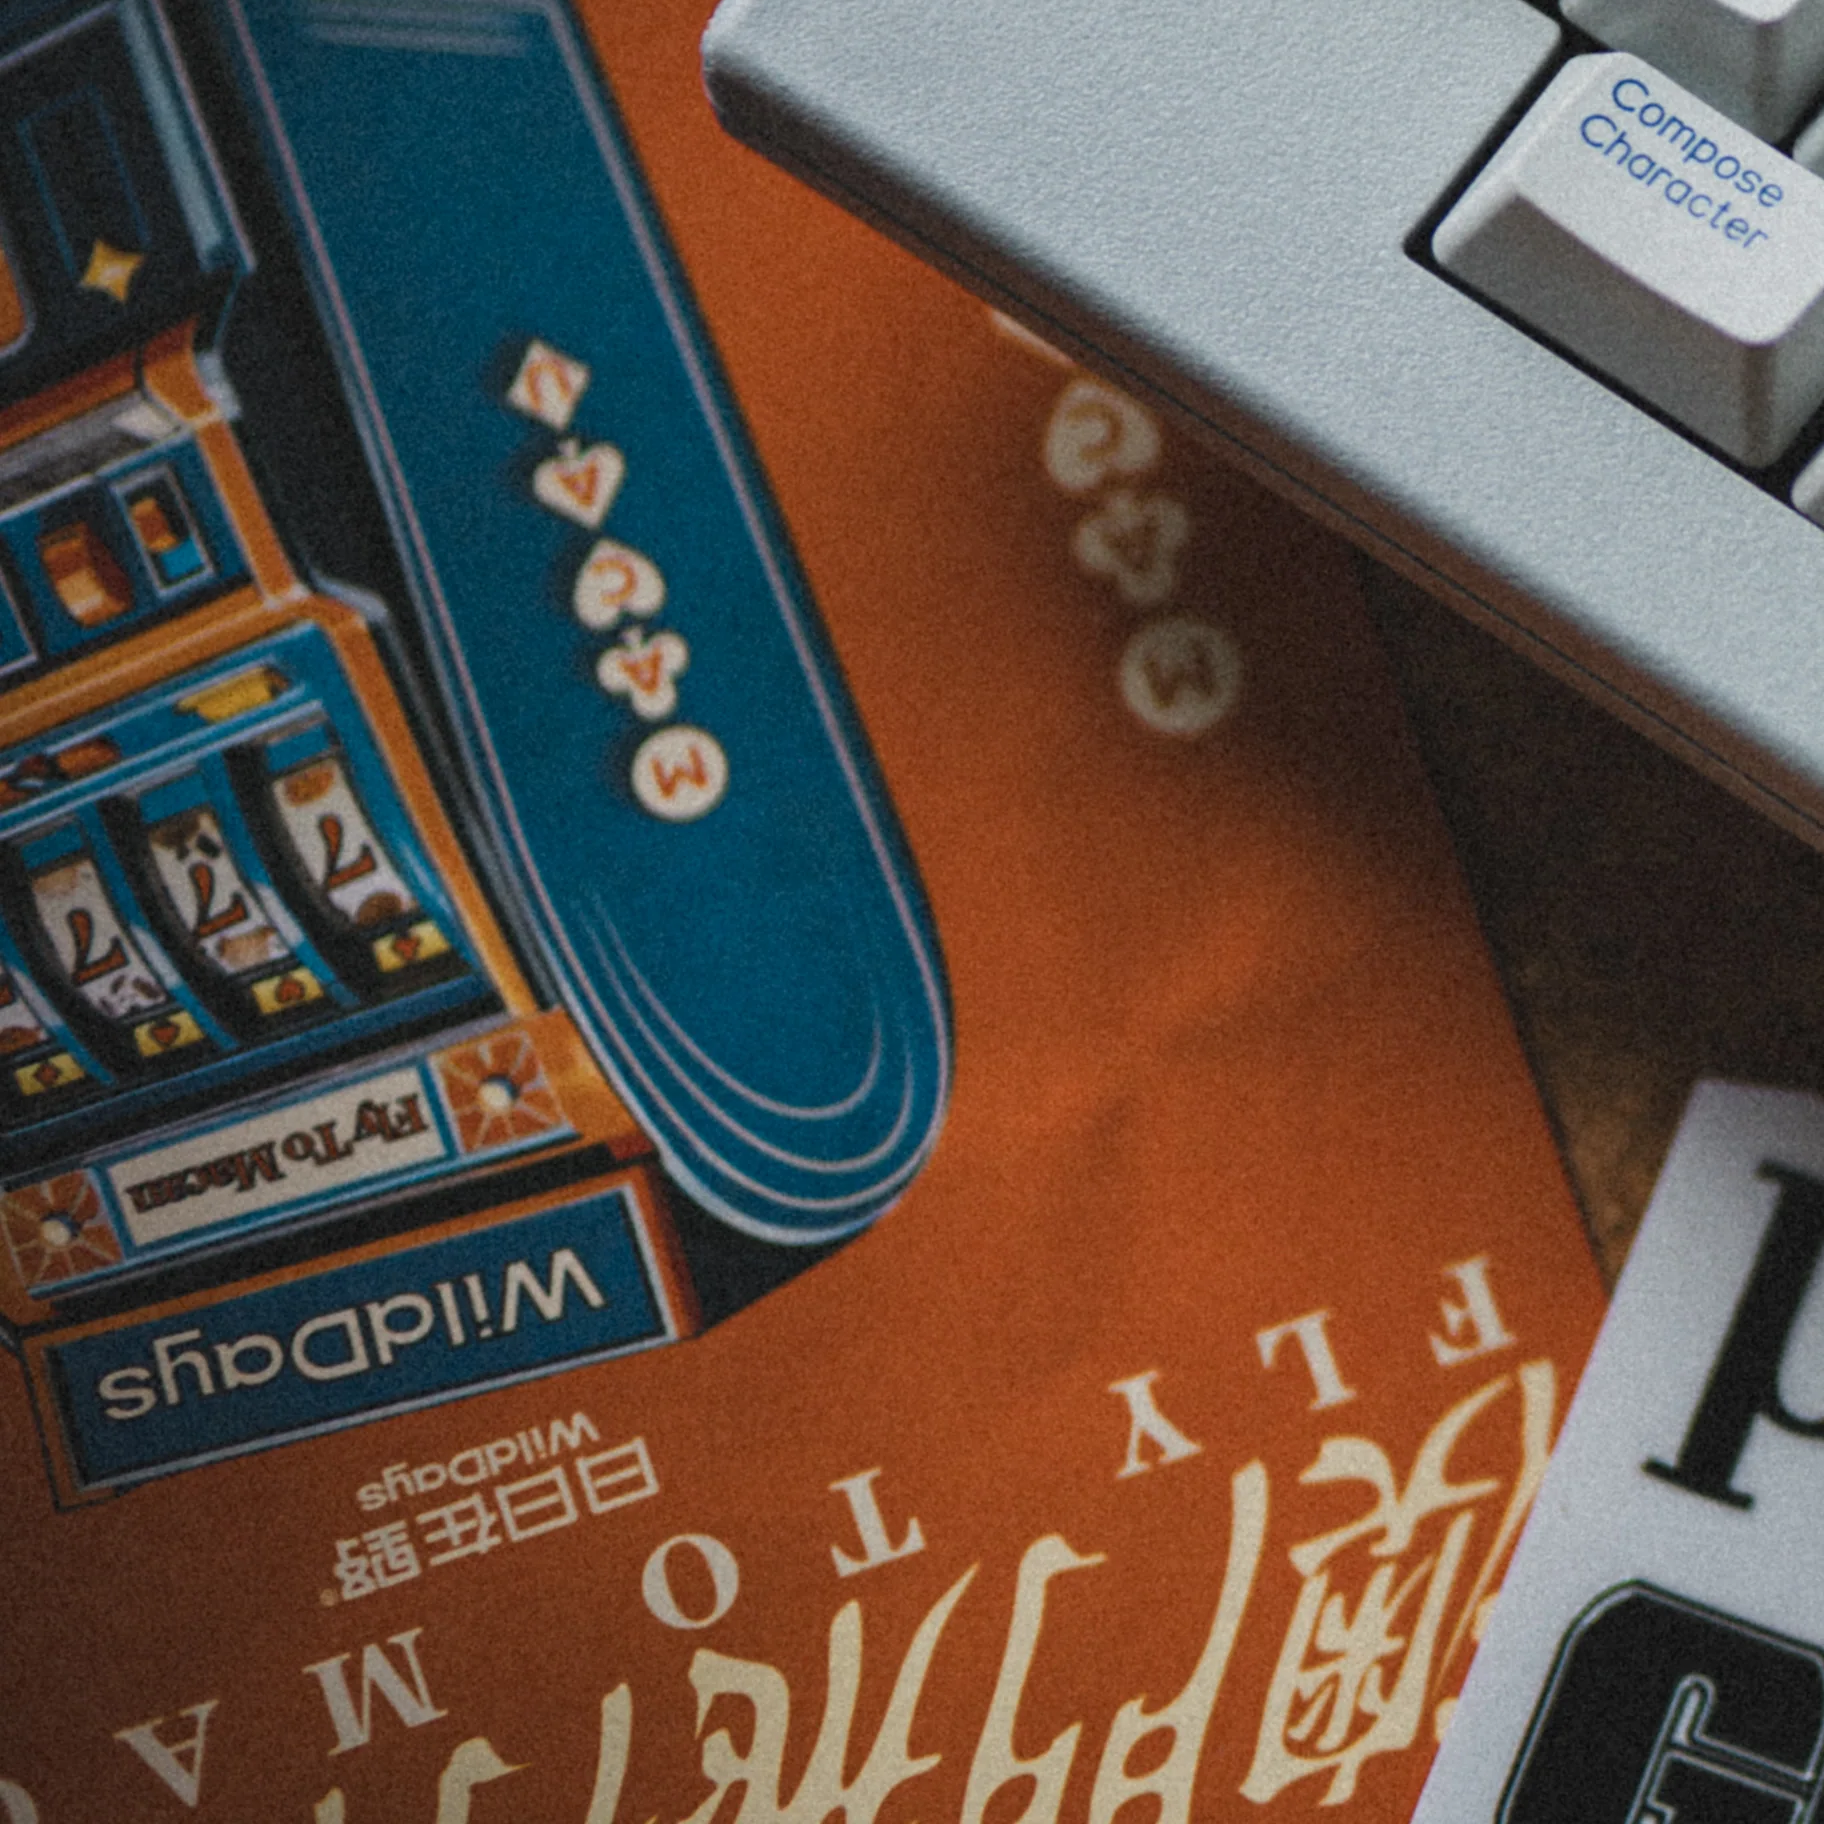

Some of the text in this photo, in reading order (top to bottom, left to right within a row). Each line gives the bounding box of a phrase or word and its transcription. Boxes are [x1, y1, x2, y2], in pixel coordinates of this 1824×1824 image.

[1578, 112, 1769, 251] Character
[1604, 78, 1781, 215] Compose
[283, 1119, 354, 1168] To
[98, 1247, 606, 1421] WildDays
[356, 1411, 601, 1513] WildDays
[0, 1251, 1517, 1824] FLY TO MA
